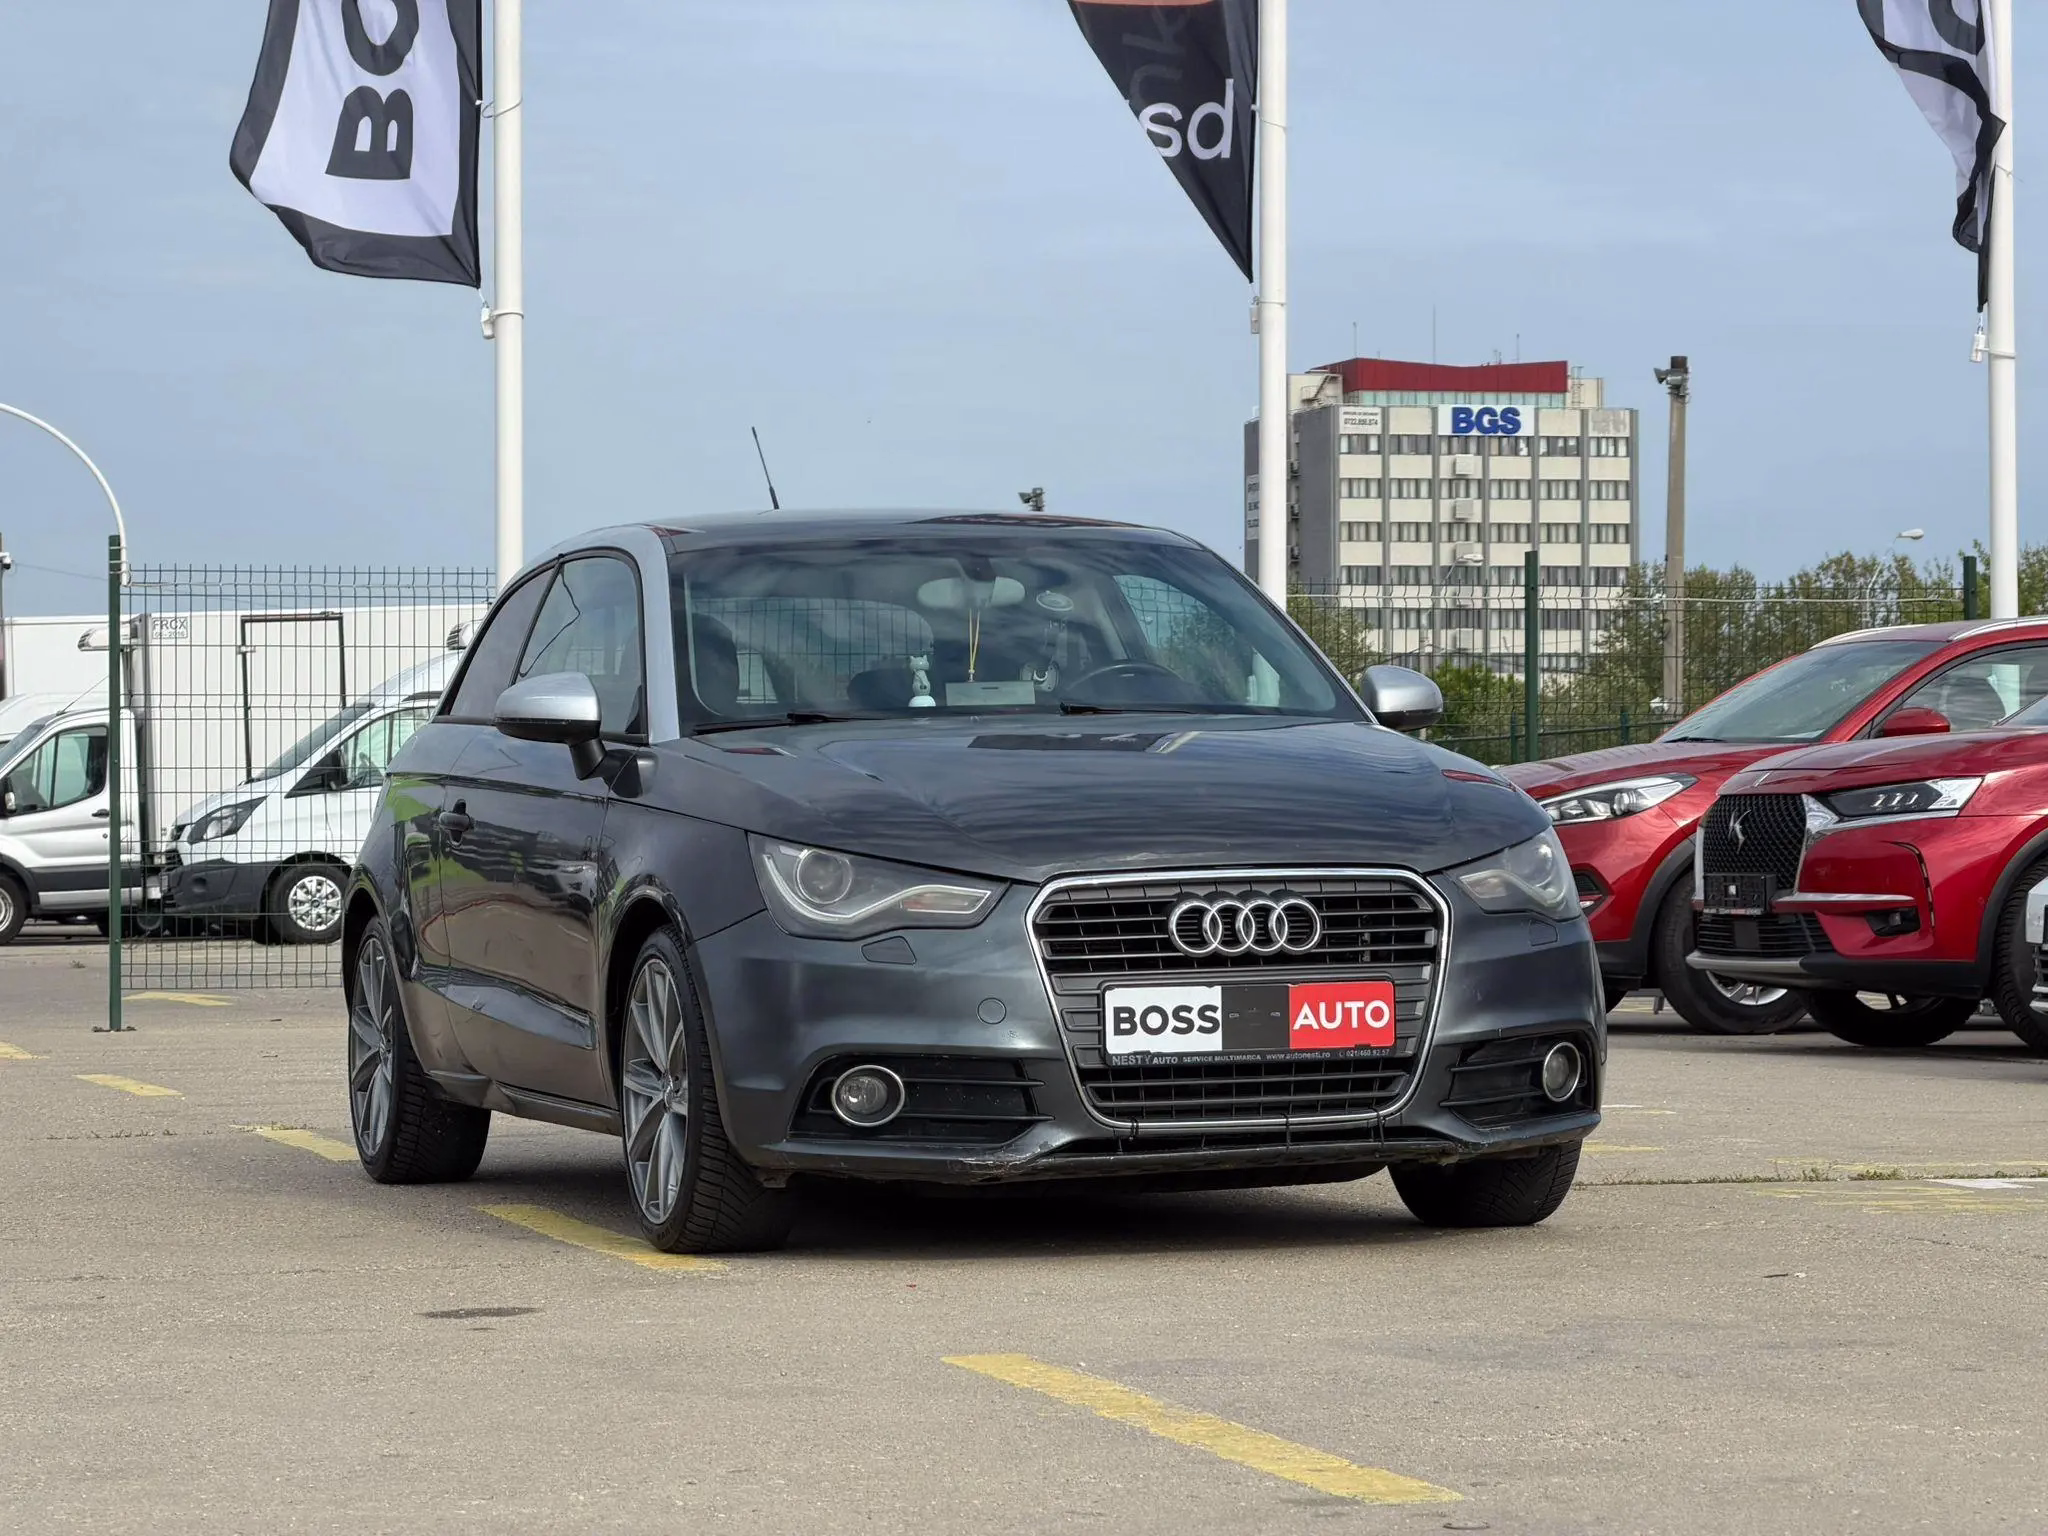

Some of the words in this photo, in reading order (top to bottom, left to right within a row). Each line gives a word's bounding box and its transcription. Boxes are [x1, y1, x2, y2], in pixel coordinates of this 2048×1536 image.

[1452, 406, 1521, 434] BGS
[153, 619, 186, 630] FRCX
[1113, 1004, 1221, 1037] BOSS
[1292, 999, 1390, 1031] AUTO
[1112, 1055, 1152, 1066] NESTY
[1153, 1056, 1178, 1064] AUTO
